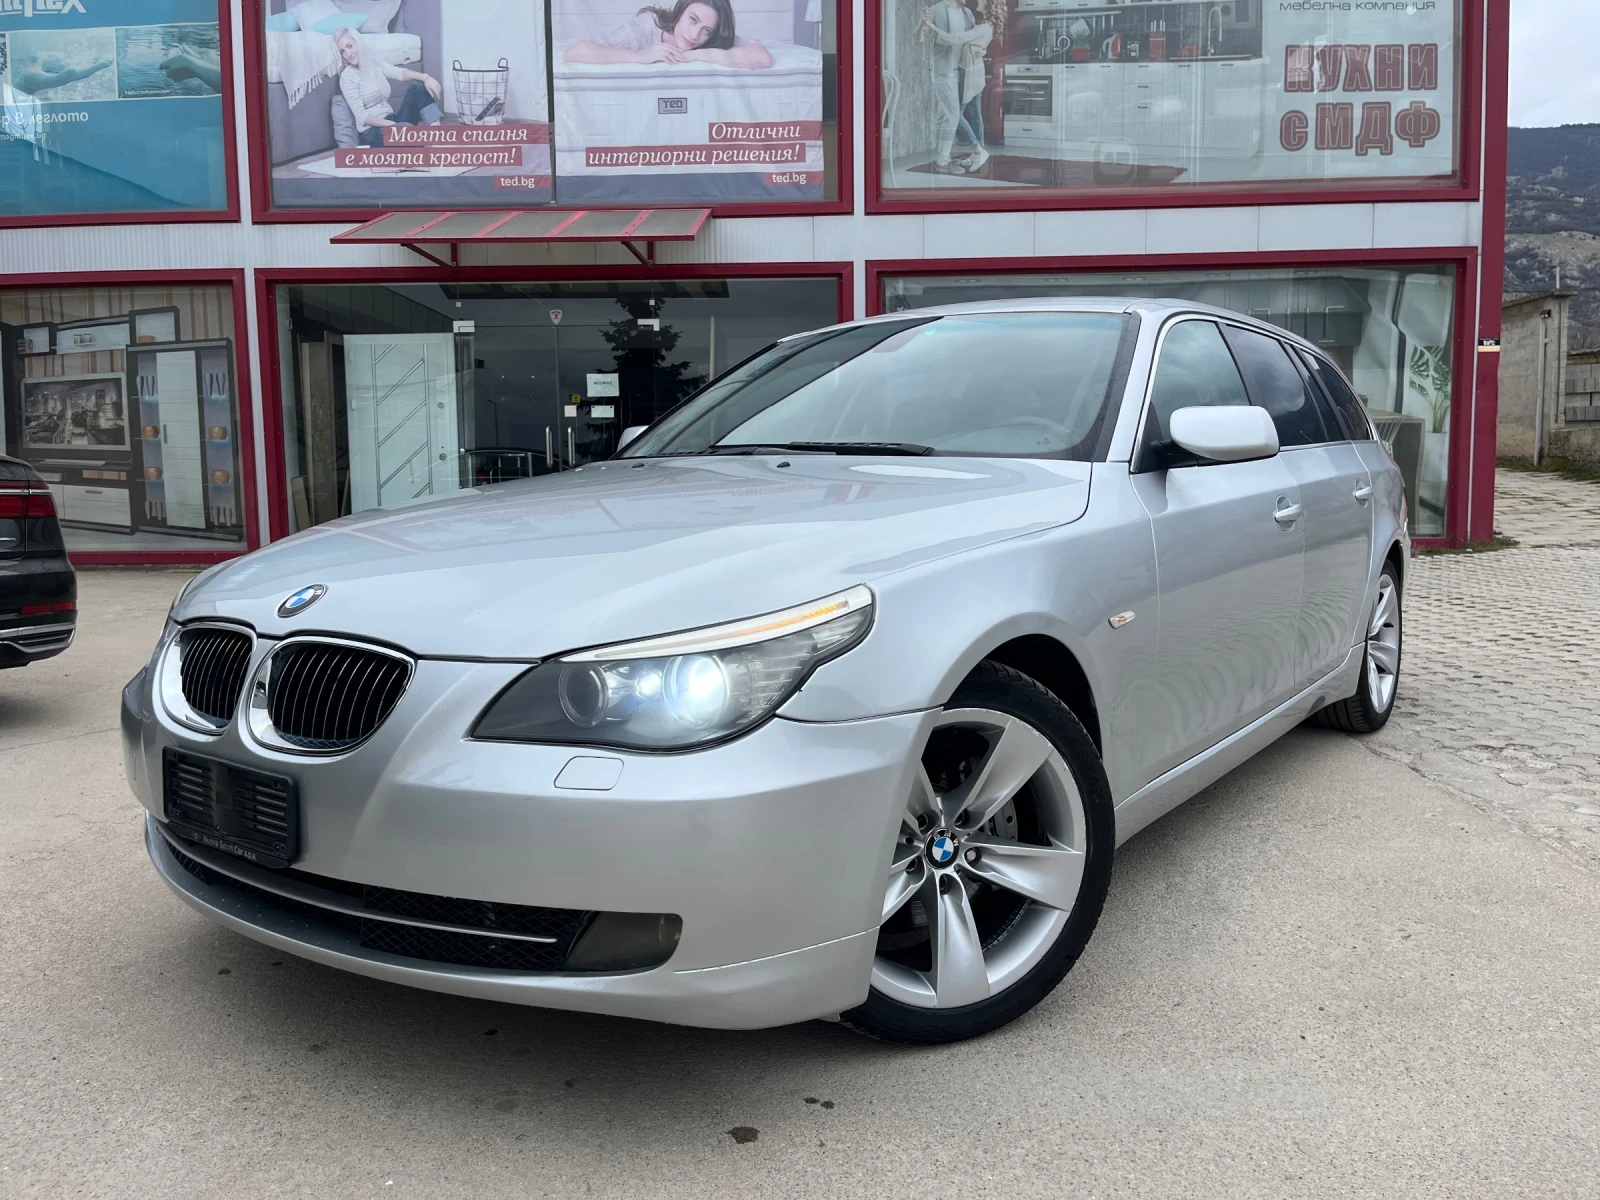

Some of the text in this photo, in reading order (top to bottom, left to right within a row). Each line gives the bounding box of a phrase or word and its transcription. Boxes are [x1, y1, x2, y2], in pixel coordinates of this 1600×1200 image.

[1279, 1, 1436, 11] мебелна компания
[1284, 43, 1438, 92] КУХНИ
[388, 126, 528, 143] Моята спалня
[711, 122, 801, 140] Отлични
[345, 145, 516, 168] е моята крепост!
[588, 144, 800, 167] интериорни решения!
[500, 176, 535, 189] ted.bg
[772, 172, 807, 185] ted.bg
[932, 830, 959, 847] BMW
